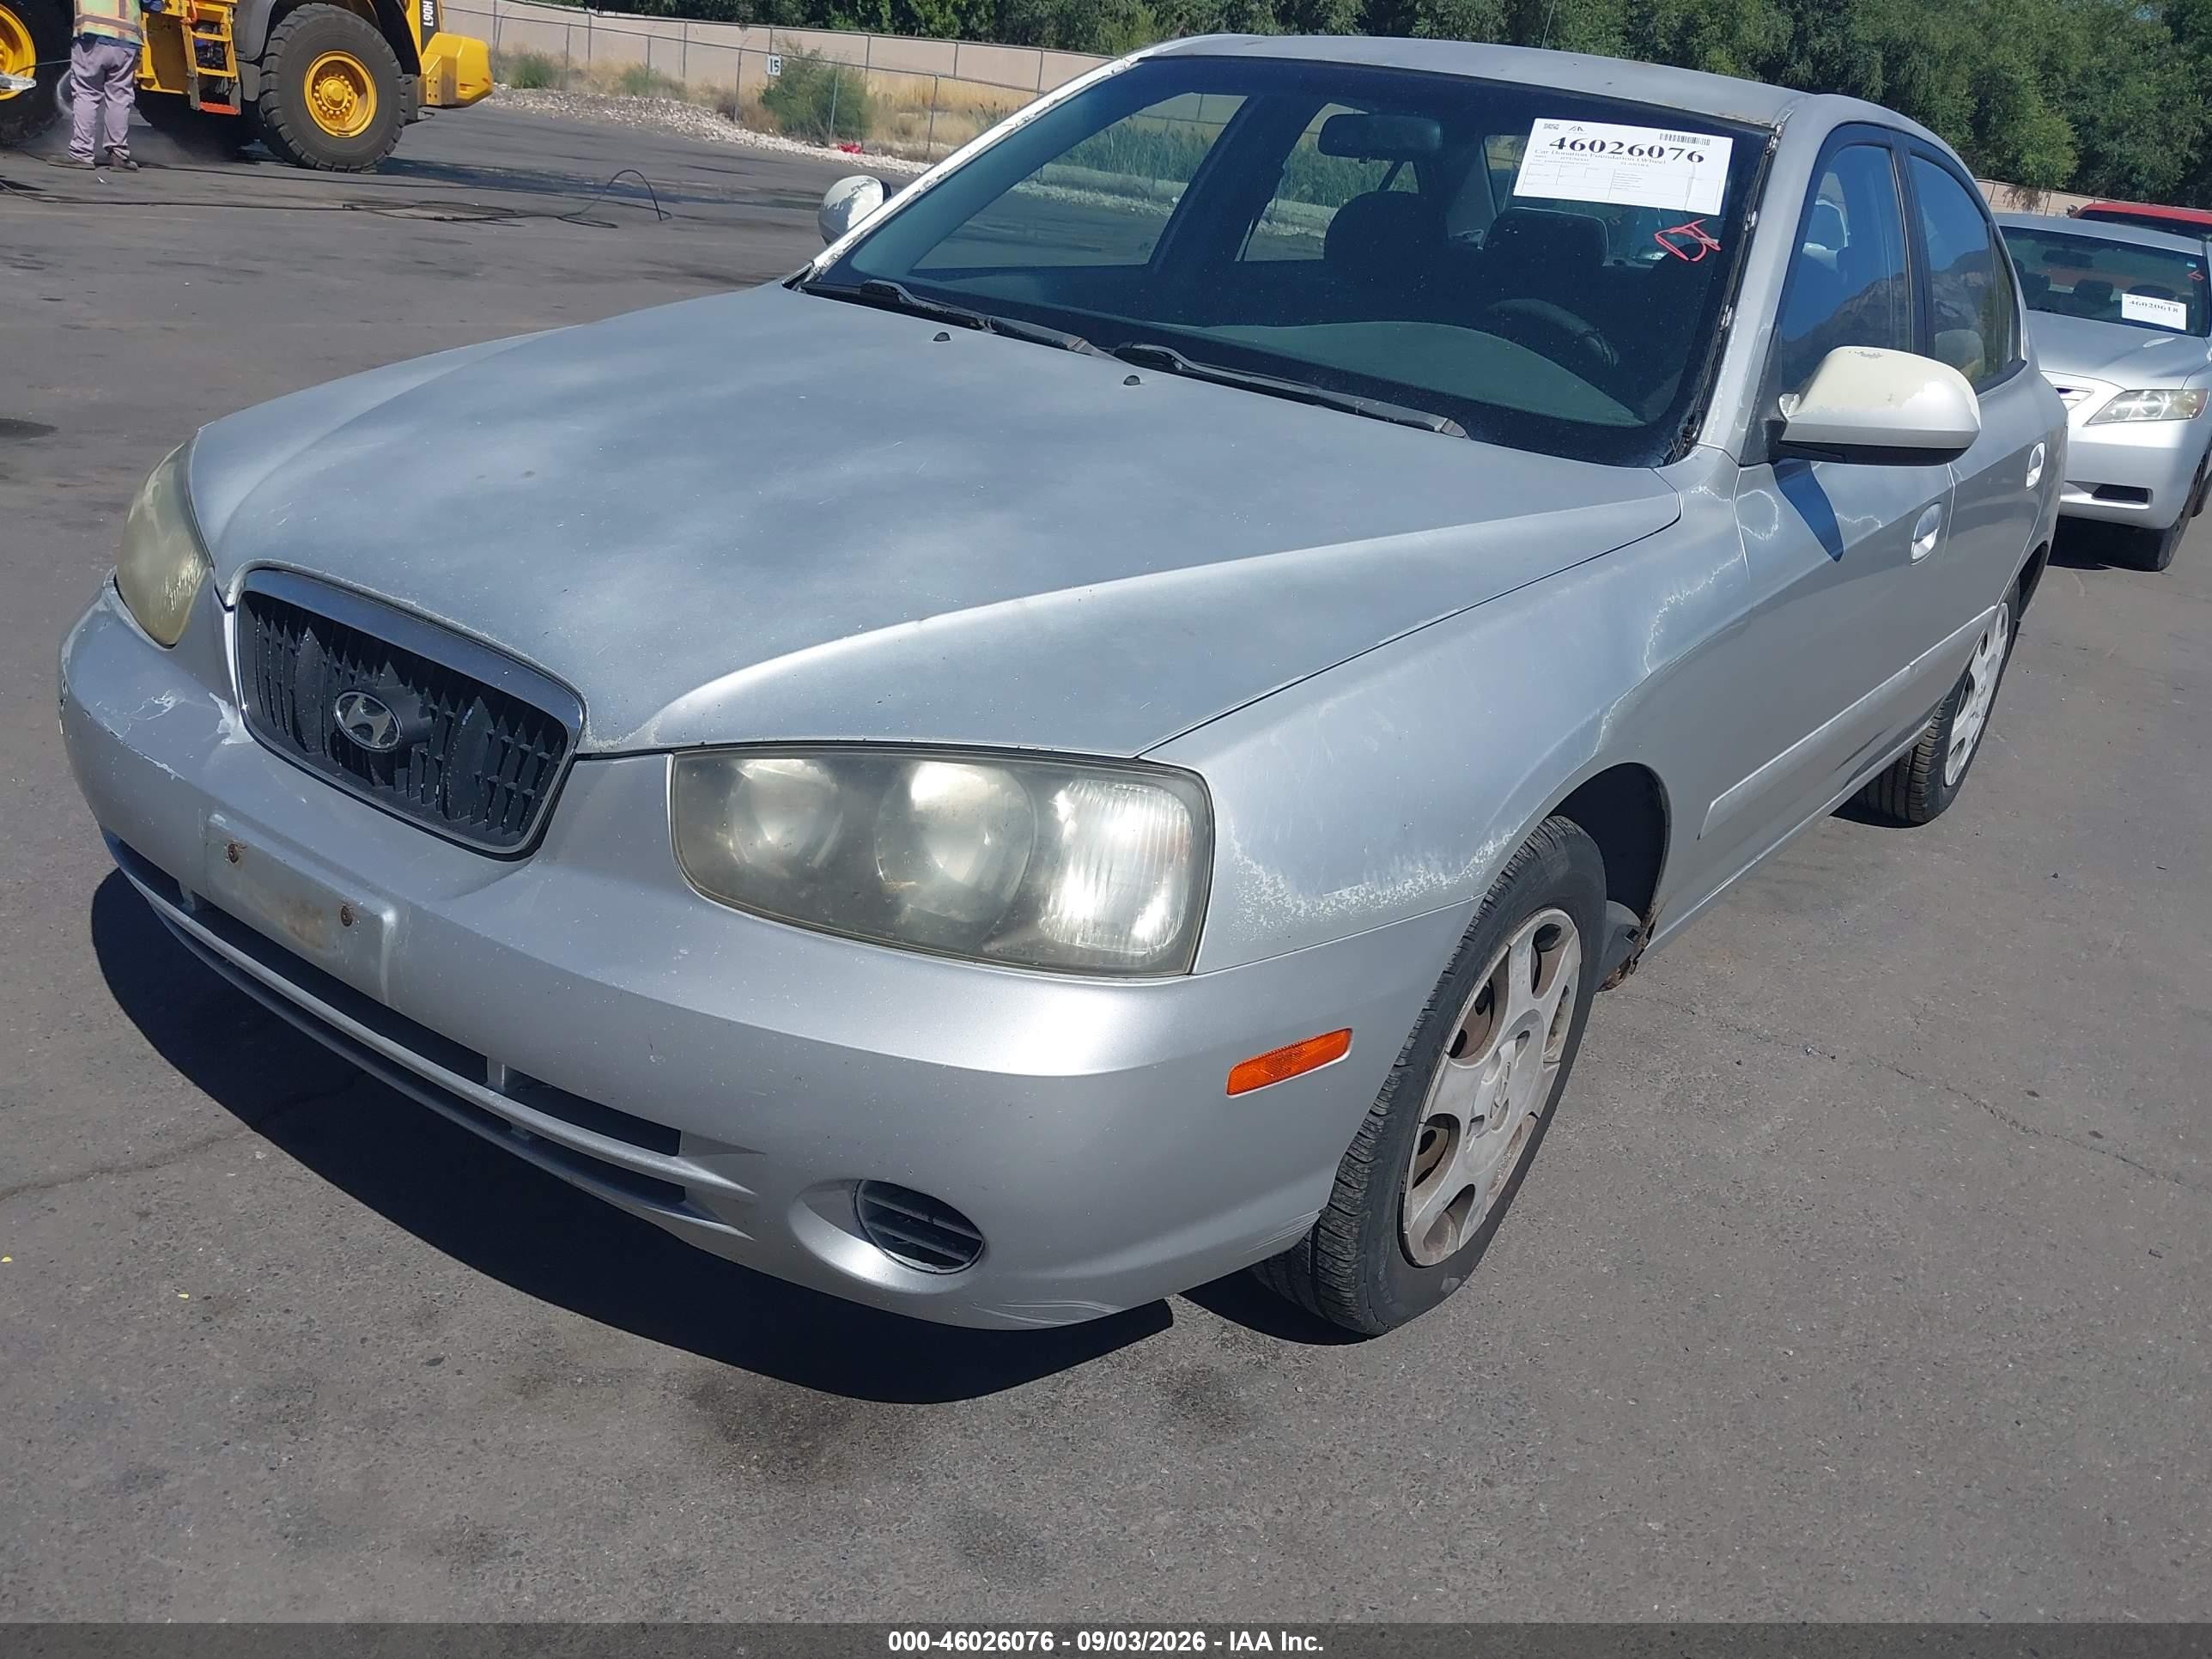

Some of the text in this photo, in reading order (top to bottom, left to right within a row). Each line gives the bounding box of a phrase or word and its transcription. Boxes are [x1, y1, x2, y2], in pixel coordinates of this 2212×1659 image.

[422, 0, 434, 27] L90H
[769, 58, 780, 73] 15
[1549, 137, 1705, 163] 46026076
